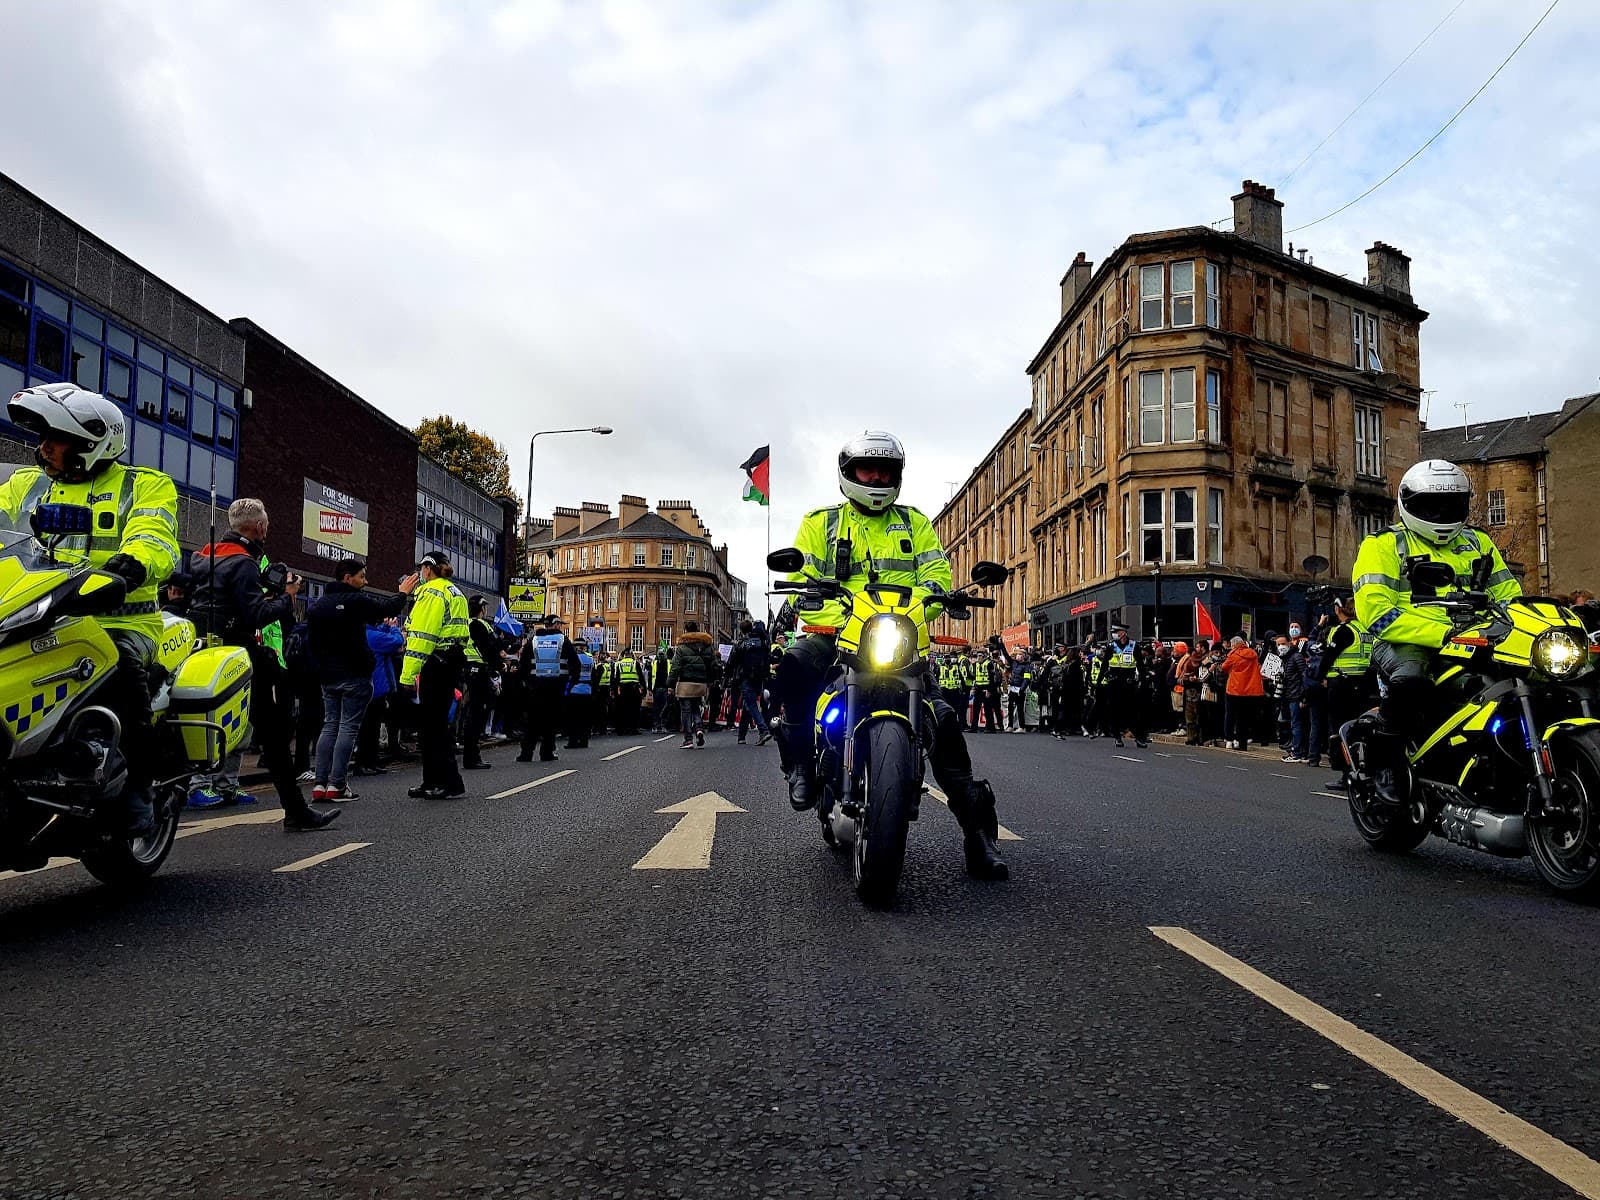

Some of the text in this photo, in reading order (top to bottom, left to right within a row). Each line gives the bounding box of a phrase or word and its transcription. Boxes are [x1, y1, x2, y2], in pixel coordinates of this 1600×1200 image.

[864, 448, 895, 457] POLICE
[322, 485, 336, 500] FOR
[337, 492, 354, 508] SALE
[320, 514, 353, 532] UNDER OFFER
[162, 624, 191, 656] POLICE
